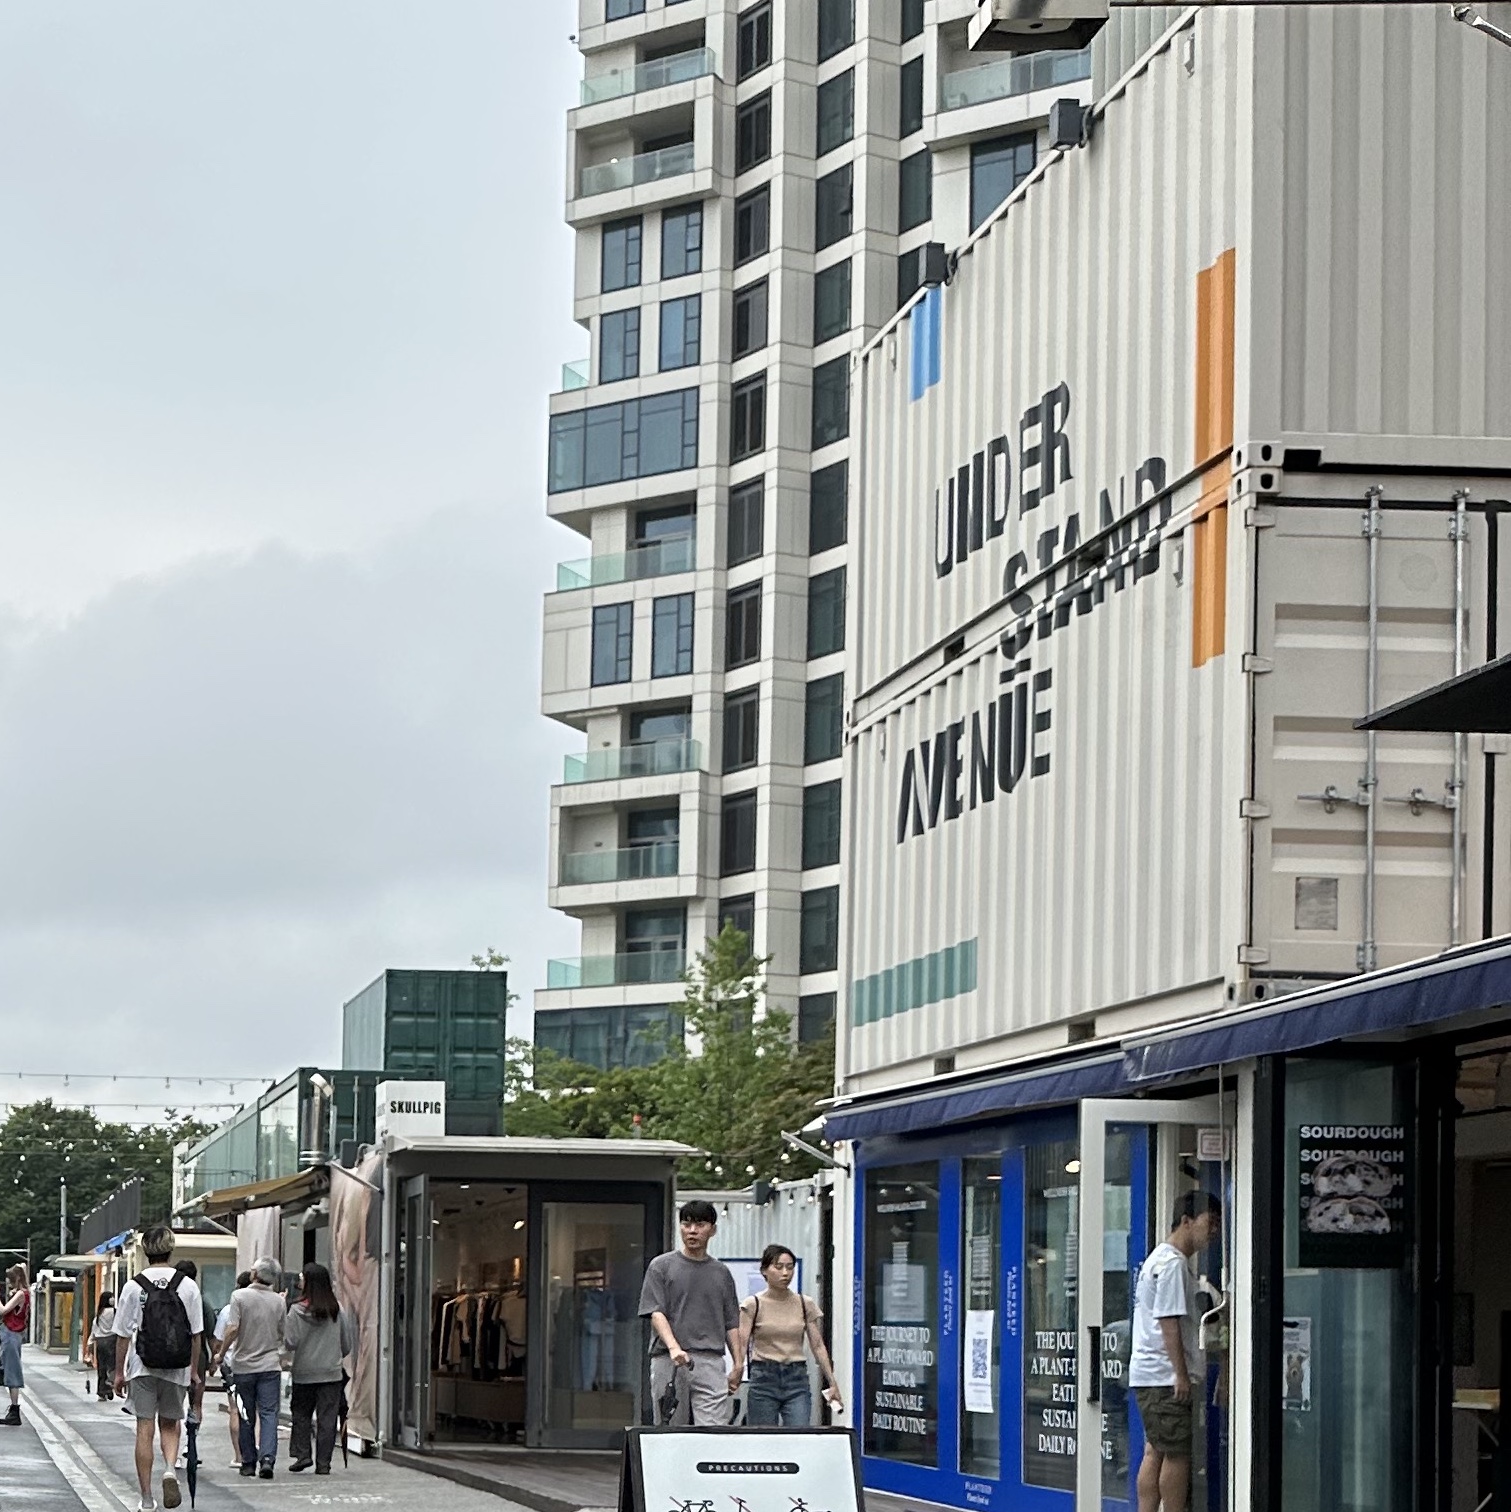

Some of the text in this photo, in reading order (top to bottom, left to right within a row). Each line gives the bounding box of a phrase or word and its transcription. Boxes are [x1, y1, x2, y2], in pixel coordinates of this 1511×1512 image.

[935, 380, 1074, 579] UNDER
[999, 456, 1173, 661] STAND
[390, 1101, 442, 1114] SKULLPIG
[1300, 1126, 1404, 1139] SOURDOUGH
[919, 1327, 930, 1343] TO
[1035, 1331, 1055, 1349] THE
[1102, 1332, 1118, 1352] TO
[1031, 1357, 1038, 1375] A
[875, 1390, 924, 1411] SUSTAINABLE
[872, 1412, 926, 1435] DAILY ROUTINE
[1038, 1433, 1066, 1455] DAILY
[708, 1464, 789, 1472] PRECAUTIONS
